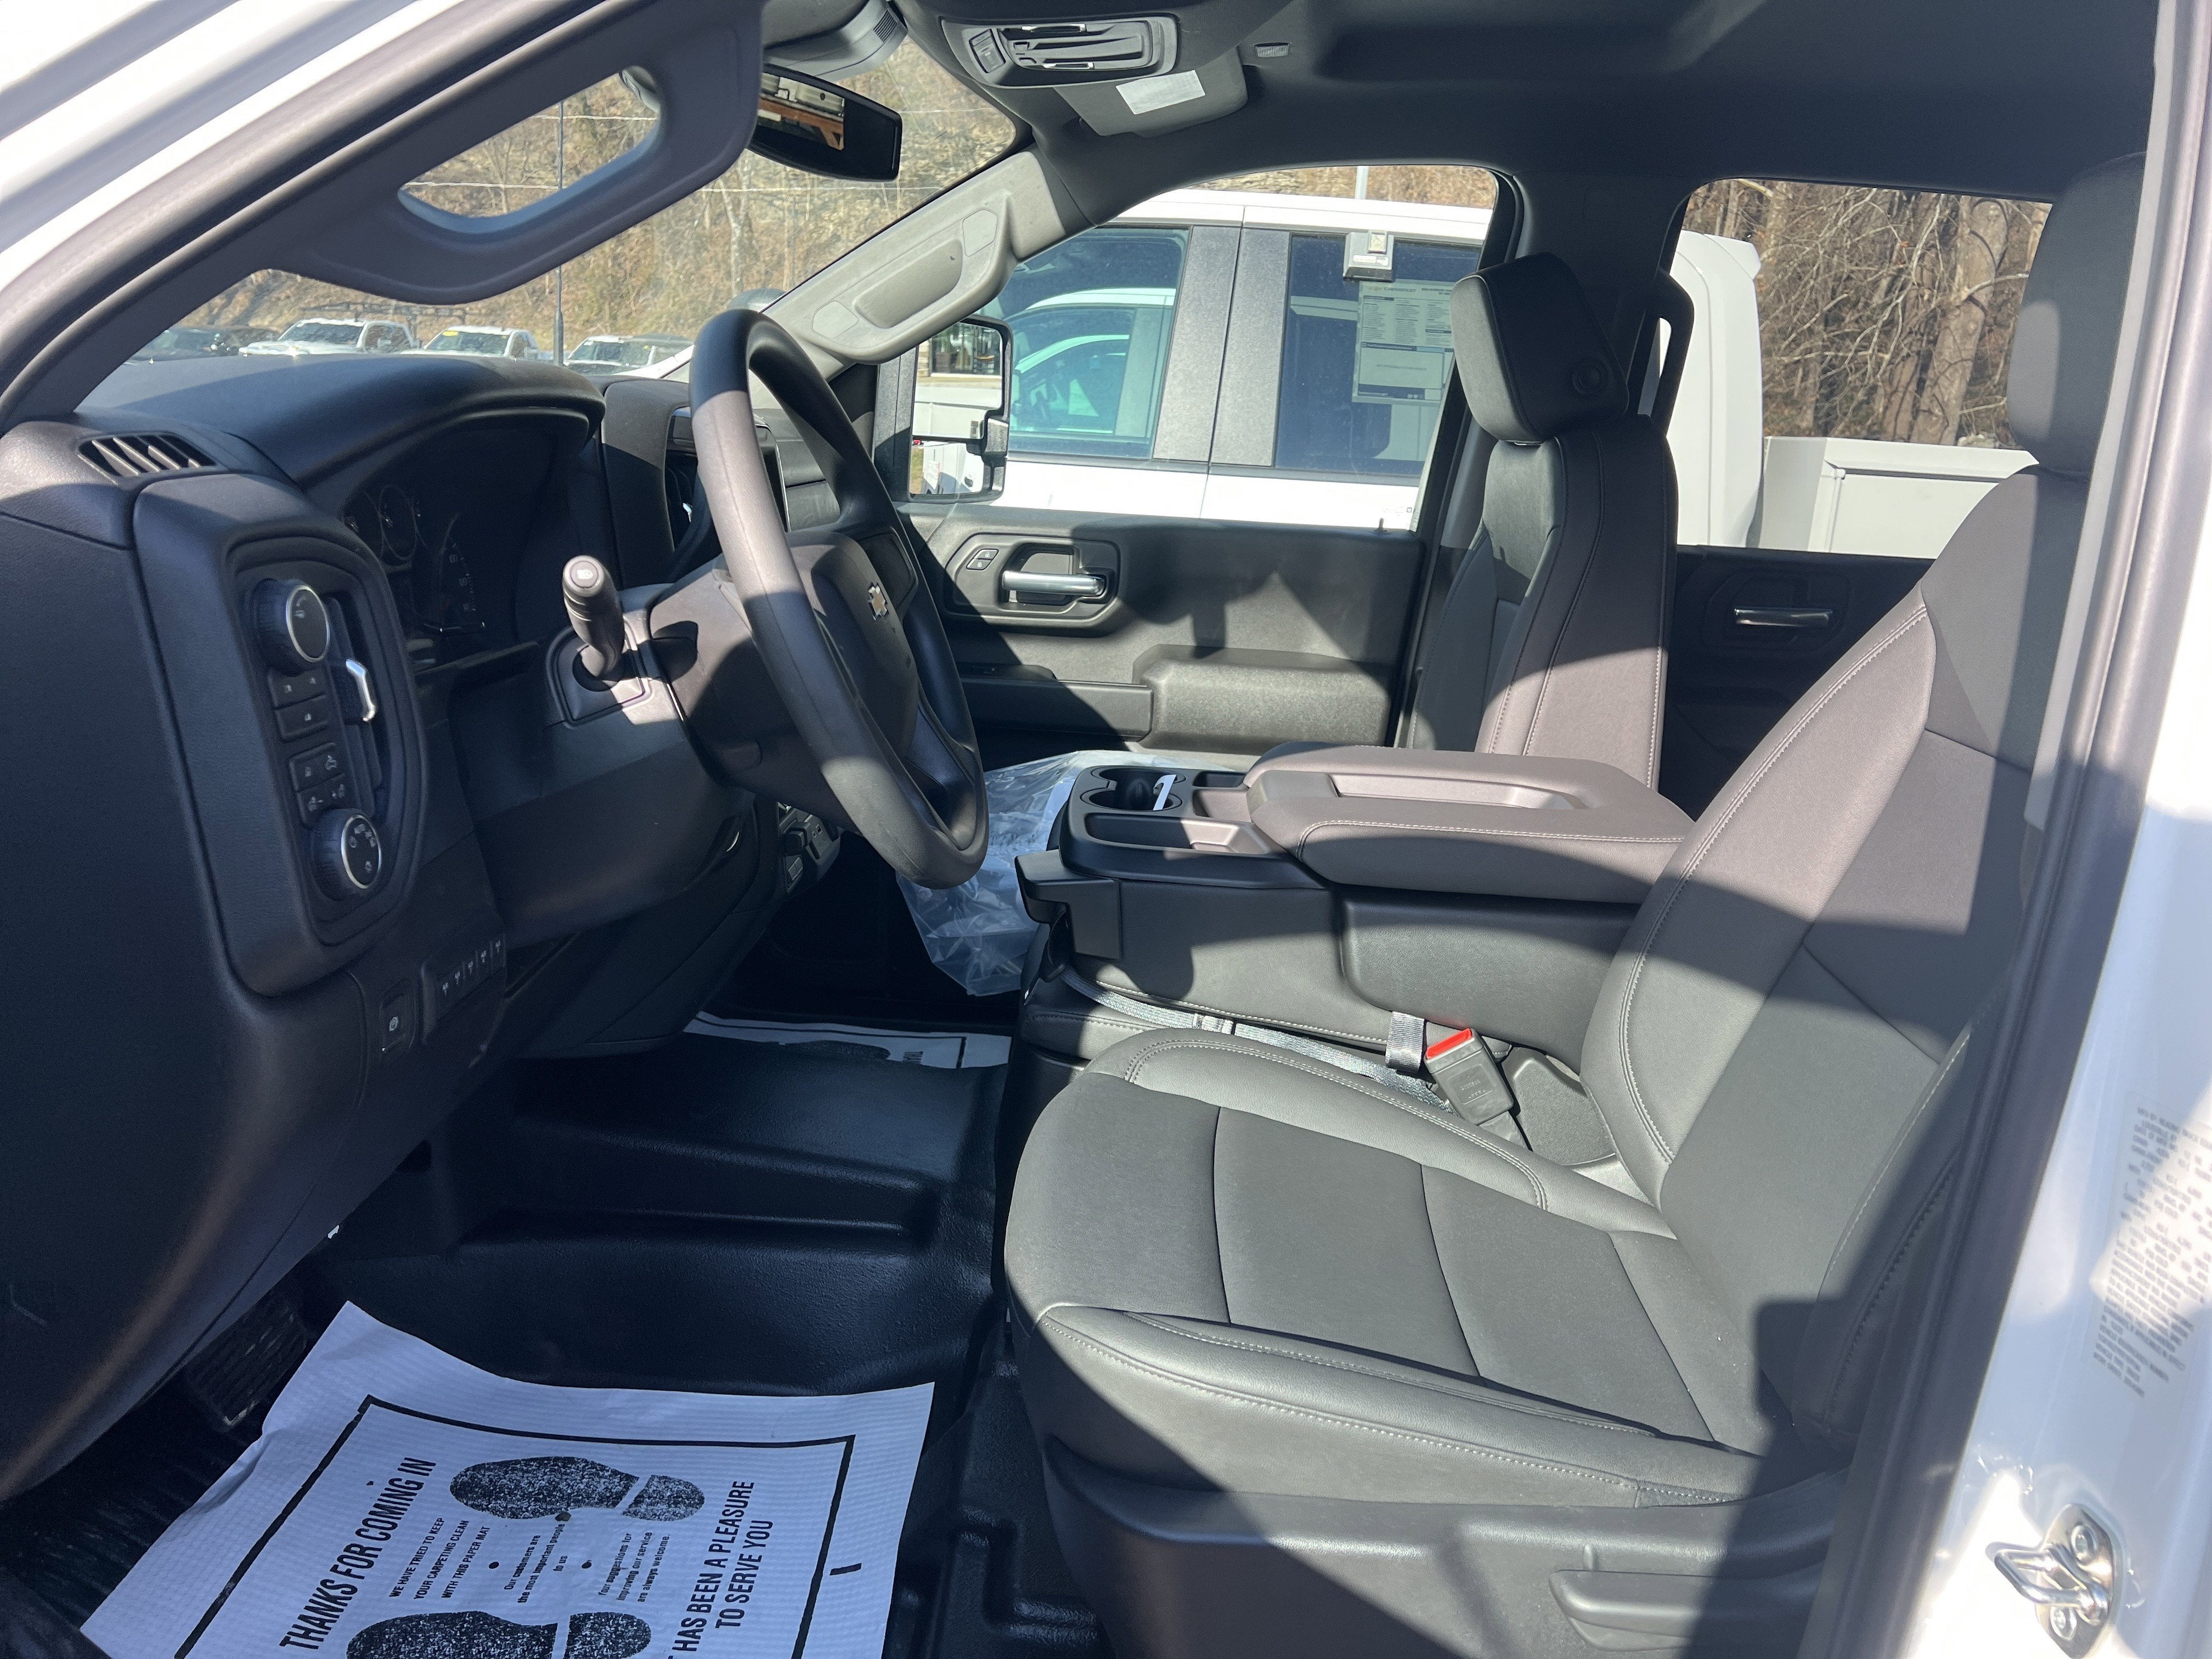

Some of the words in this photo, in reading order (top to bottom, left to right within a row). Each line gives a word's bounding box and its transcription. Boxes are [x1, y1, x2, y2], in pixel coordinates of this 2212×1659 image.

[397, 1457, 437, 1476] IN
[355, 1478, 424, 1541] COMING
[708, 1481, 754, 1553] PLEASURE
[622, 1533, 631, 1543] for
[637, 1532, 652, 1556] service
[743, 1521, 773, 1548] YOU
[330, 1543, 383, 1579] FOR
[389, 1586, 404, 1597] WE
[398, 1567, 416, 1584] HAVE
[409, 1546, 428, 1566] TRIED
[422, 1536, 435, 1545] TO
[429, 1518, 445, 1534] KEEP
[414, 1580, 433, 1599] YOUR
[427, 1542, 456, 1579] CARPETING
[450, 1520, 470, 1541] CLEAN
[441, 1581, 459, 1598] WITH
[452, 1564, 469, 1579] THIS
[462, 1542, 482, 1563] PAPER
[476, 1526, 490, 1541] MAT
[504, 1579, 517, 1589] Our
[530, 1535, 540, 1545] are
[517, 1592, 530, 1603] the
[525, 1575, 539, 1590] most
[550, 1524, 565, 1543] people
[558, 1555, 568, 1564] us
[633, 1558, 642, 1569] our
[704, 1558, 728, 1568] A
[686, 1573, 723, 1613] BEEN
[725, 1554, 762, 1603] SERVE
[279, 1579, 358, 1650] THANKS
[637, 1593, 648, 1602] are
[672, 1618, 707, 1651] HAS
[715, 1608, 744, 1628] TO
